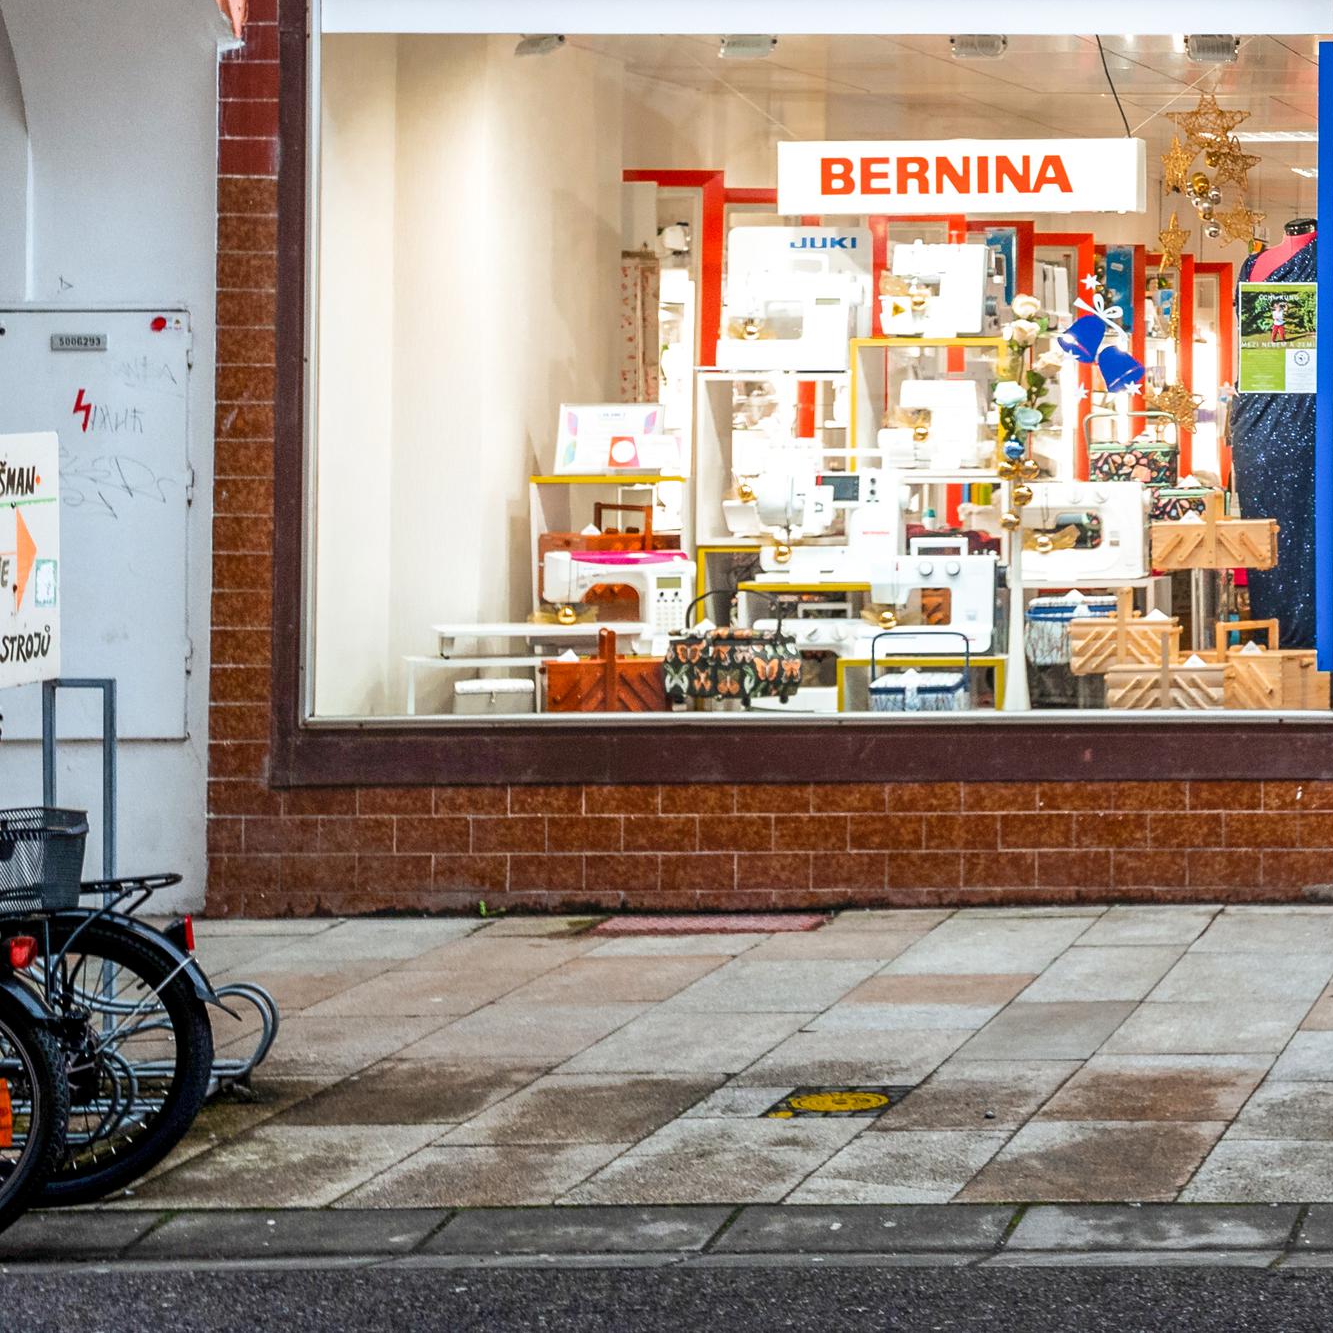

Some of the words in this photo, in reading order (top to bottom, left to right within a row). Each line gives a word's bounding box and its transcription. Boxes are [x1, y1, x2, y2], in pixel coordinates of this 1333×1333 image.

[819, 154, 1074, 196] BERNINA
[789, 236, 858, 250] JUKI
[0, 625, 51, 664] STROJŮ
